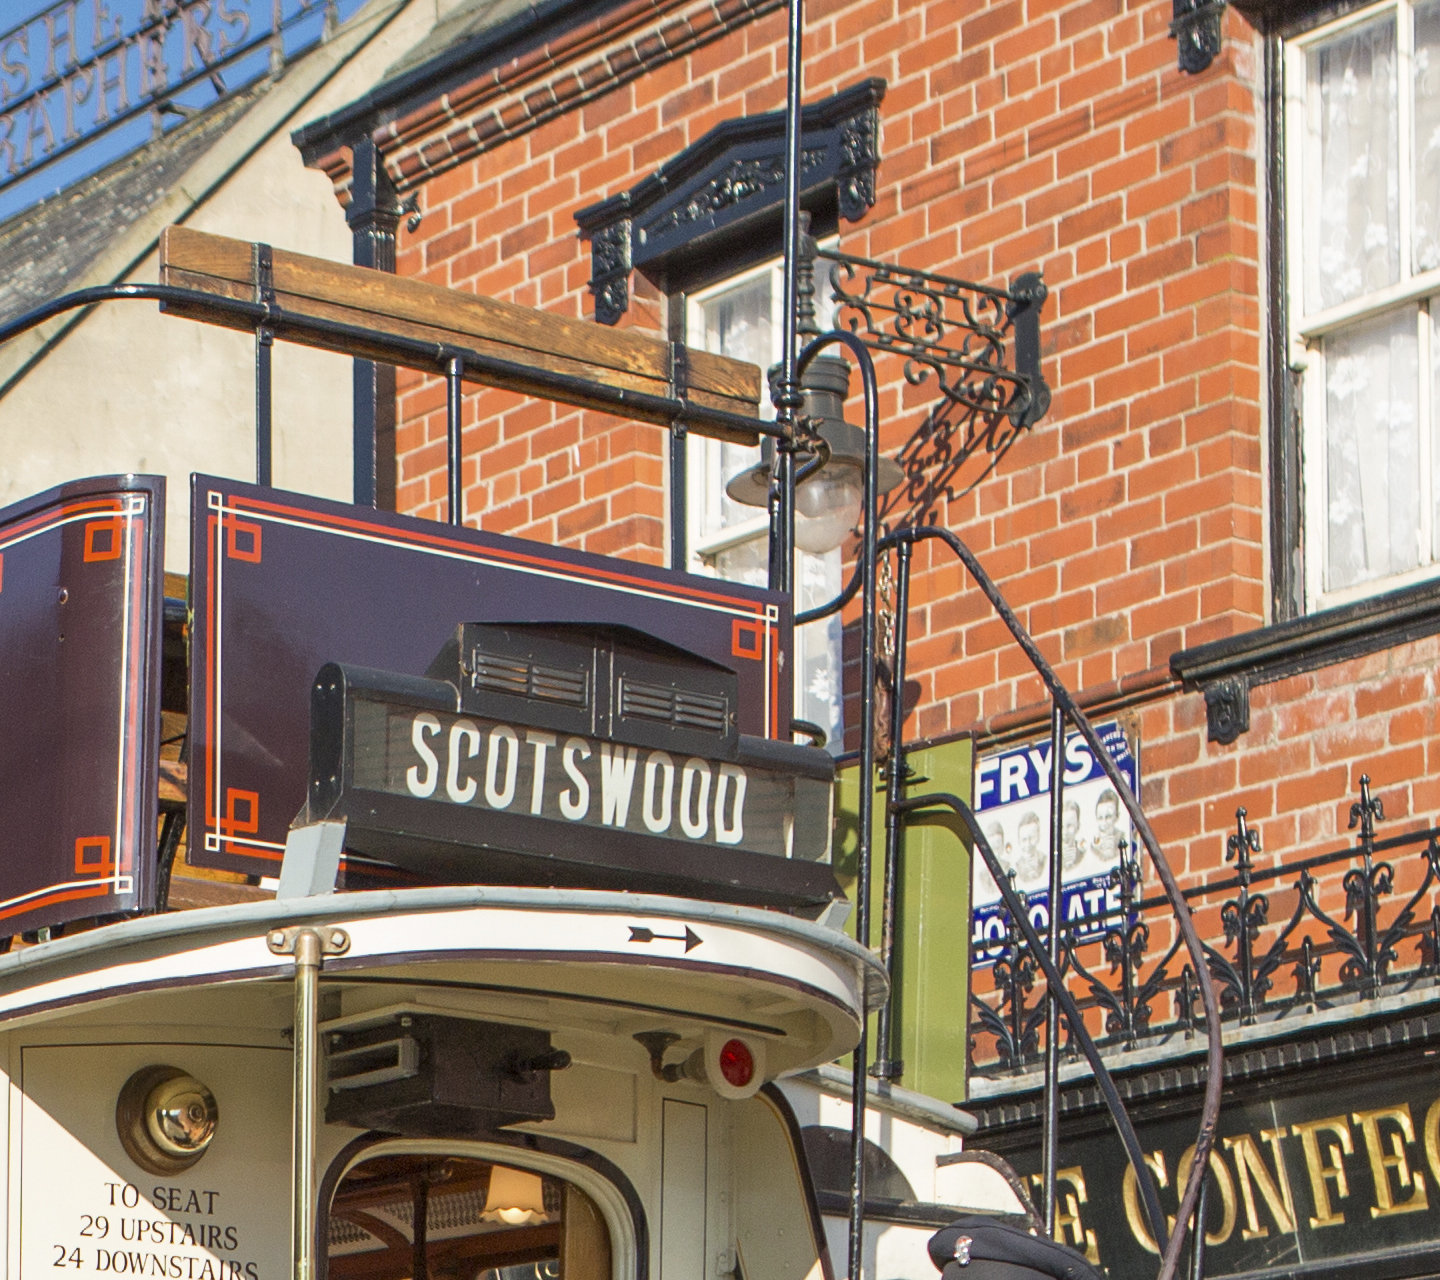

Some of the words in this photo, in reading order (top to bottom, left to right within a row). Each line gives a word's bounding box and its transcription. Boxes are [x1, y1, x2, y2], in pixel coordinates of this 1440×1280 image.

[406, 711, 746, 845] SCOTSWOOD
[104, 1183, 139, 1208] TO
[152, 1186, 220, 1215] SEAT
[79, 1214, 110, 1239] 29
[121, 1218, 238, 1250] UPSTAIRS
[53, 1244, 84, 1269] 24
